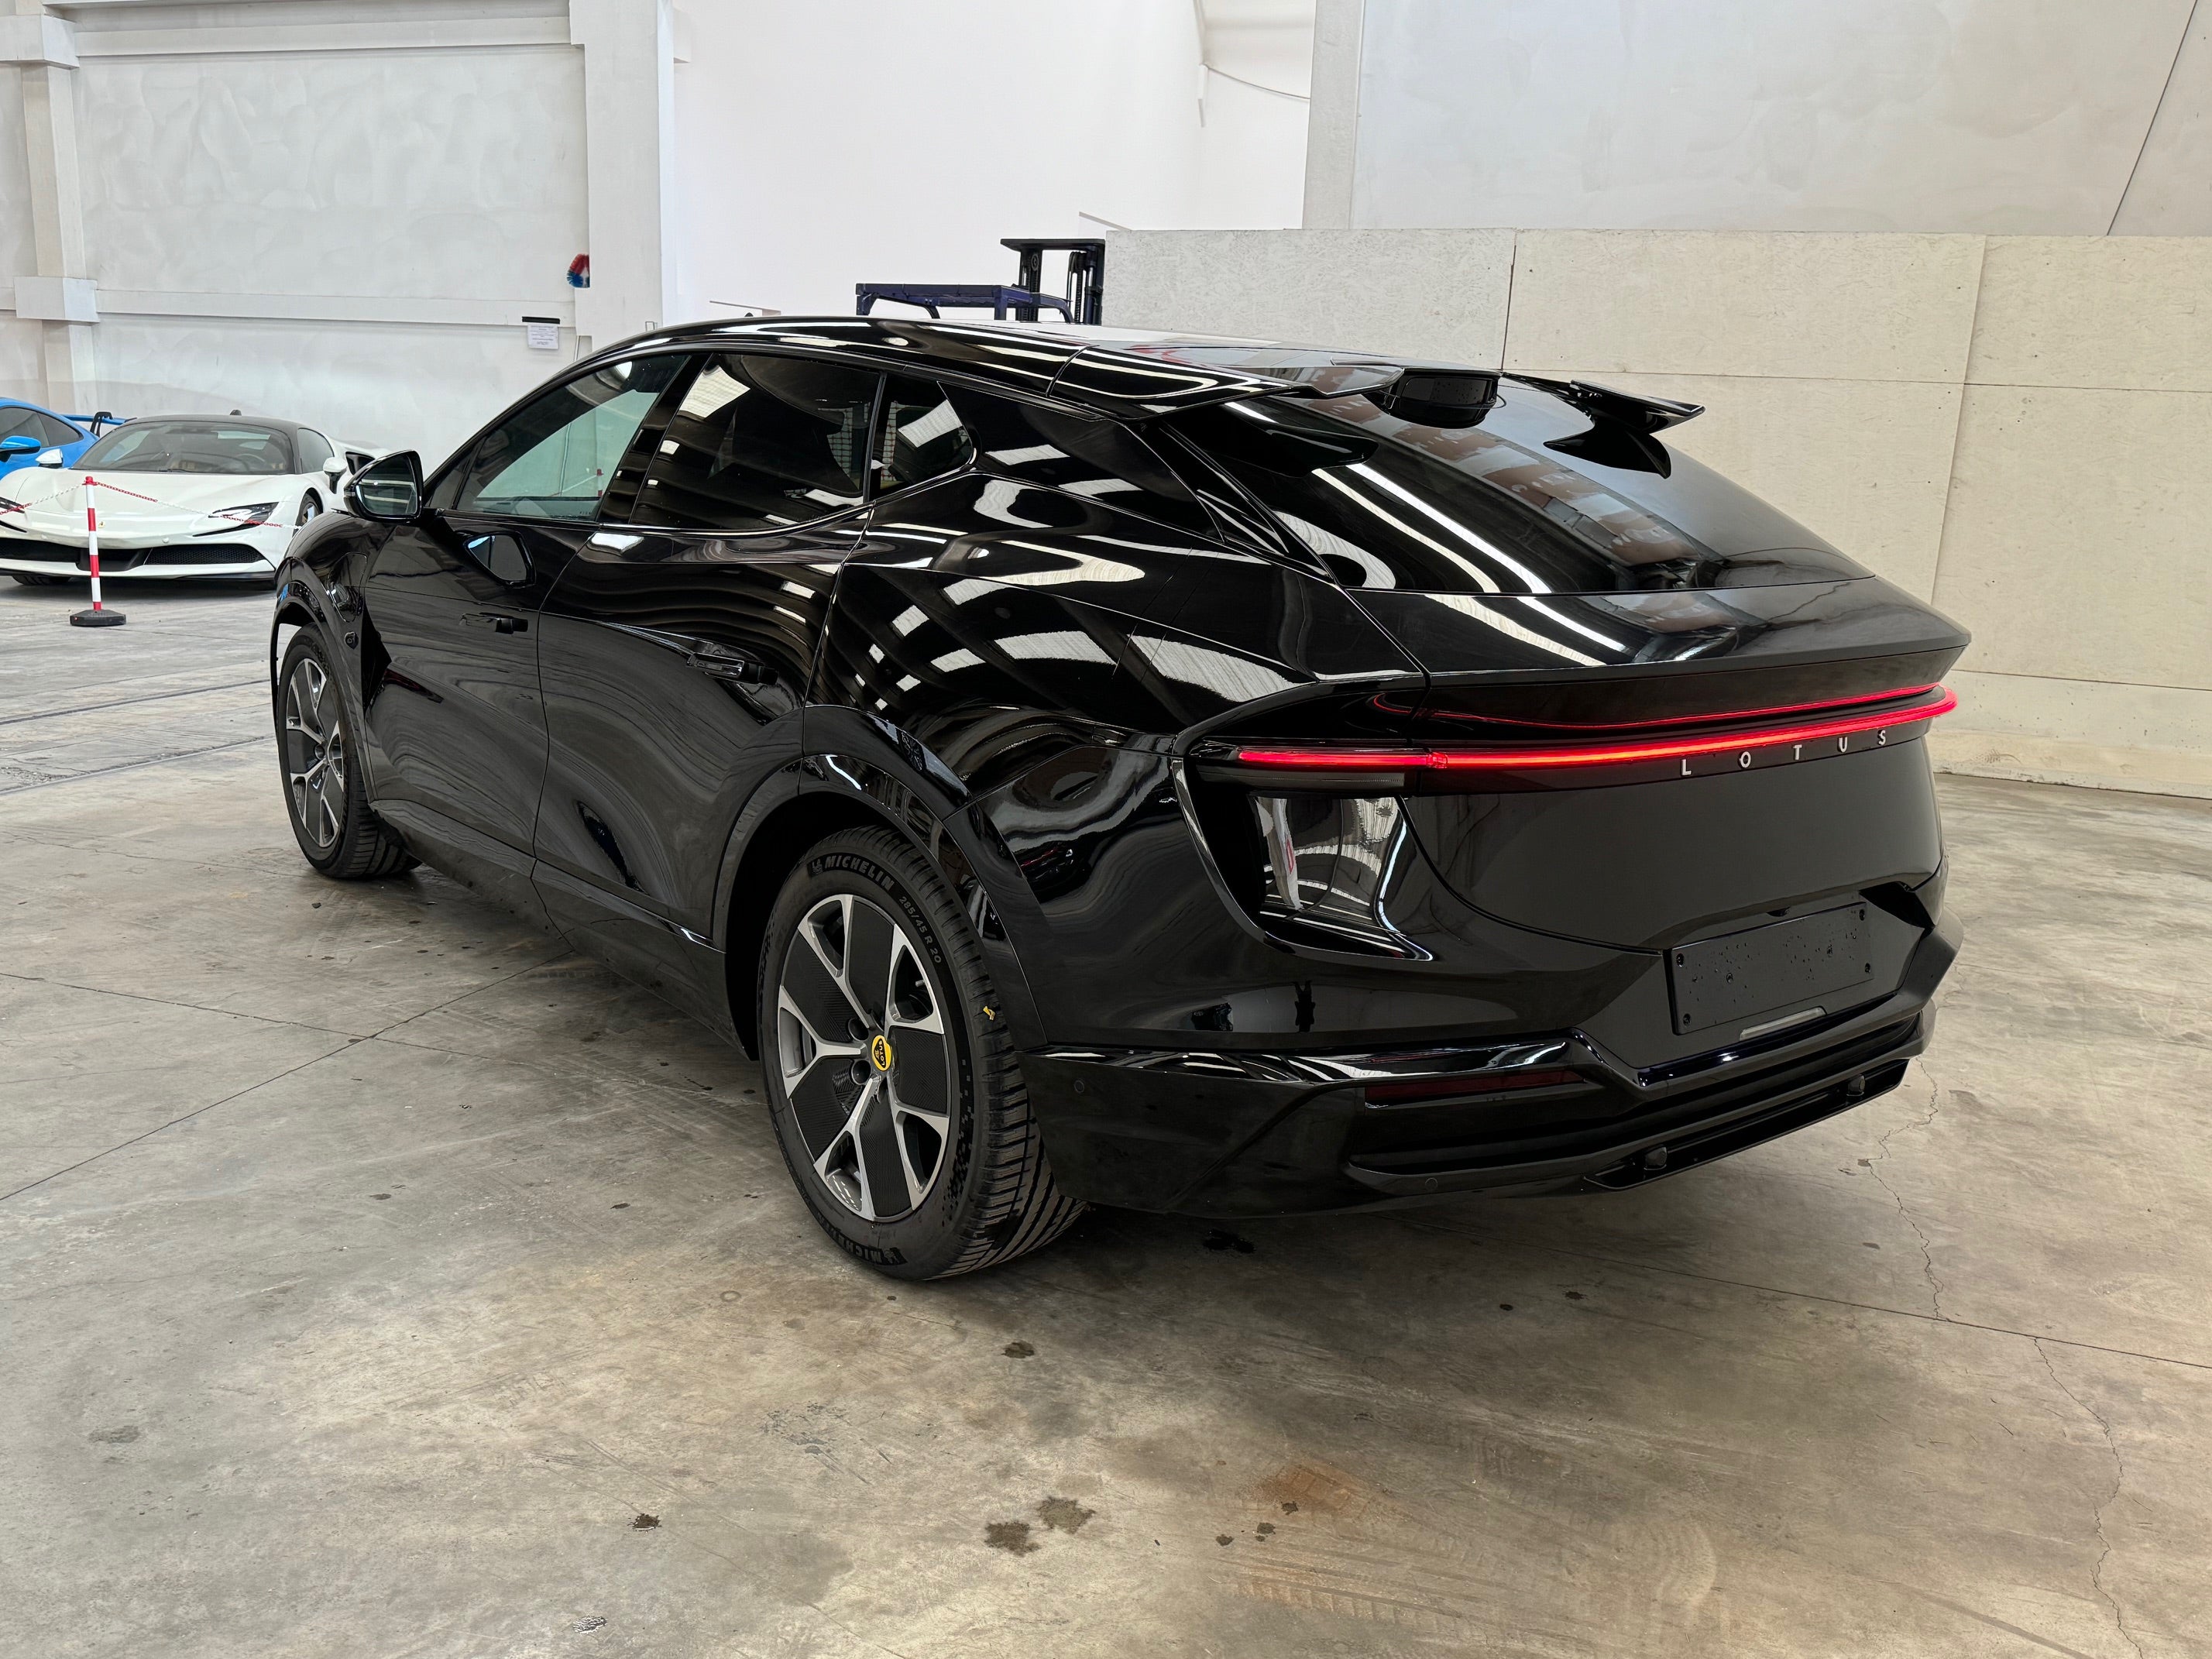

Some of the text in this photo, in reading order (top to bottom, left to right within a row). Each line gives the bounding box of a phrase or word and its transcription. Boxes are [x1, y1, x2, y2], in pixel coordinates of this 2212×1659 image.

[1680, 729, 1887, 777] LOTUS
[824, 854, 895, 891] MICHELIN
[898, 896, 943, 964] 285/45 R 20
